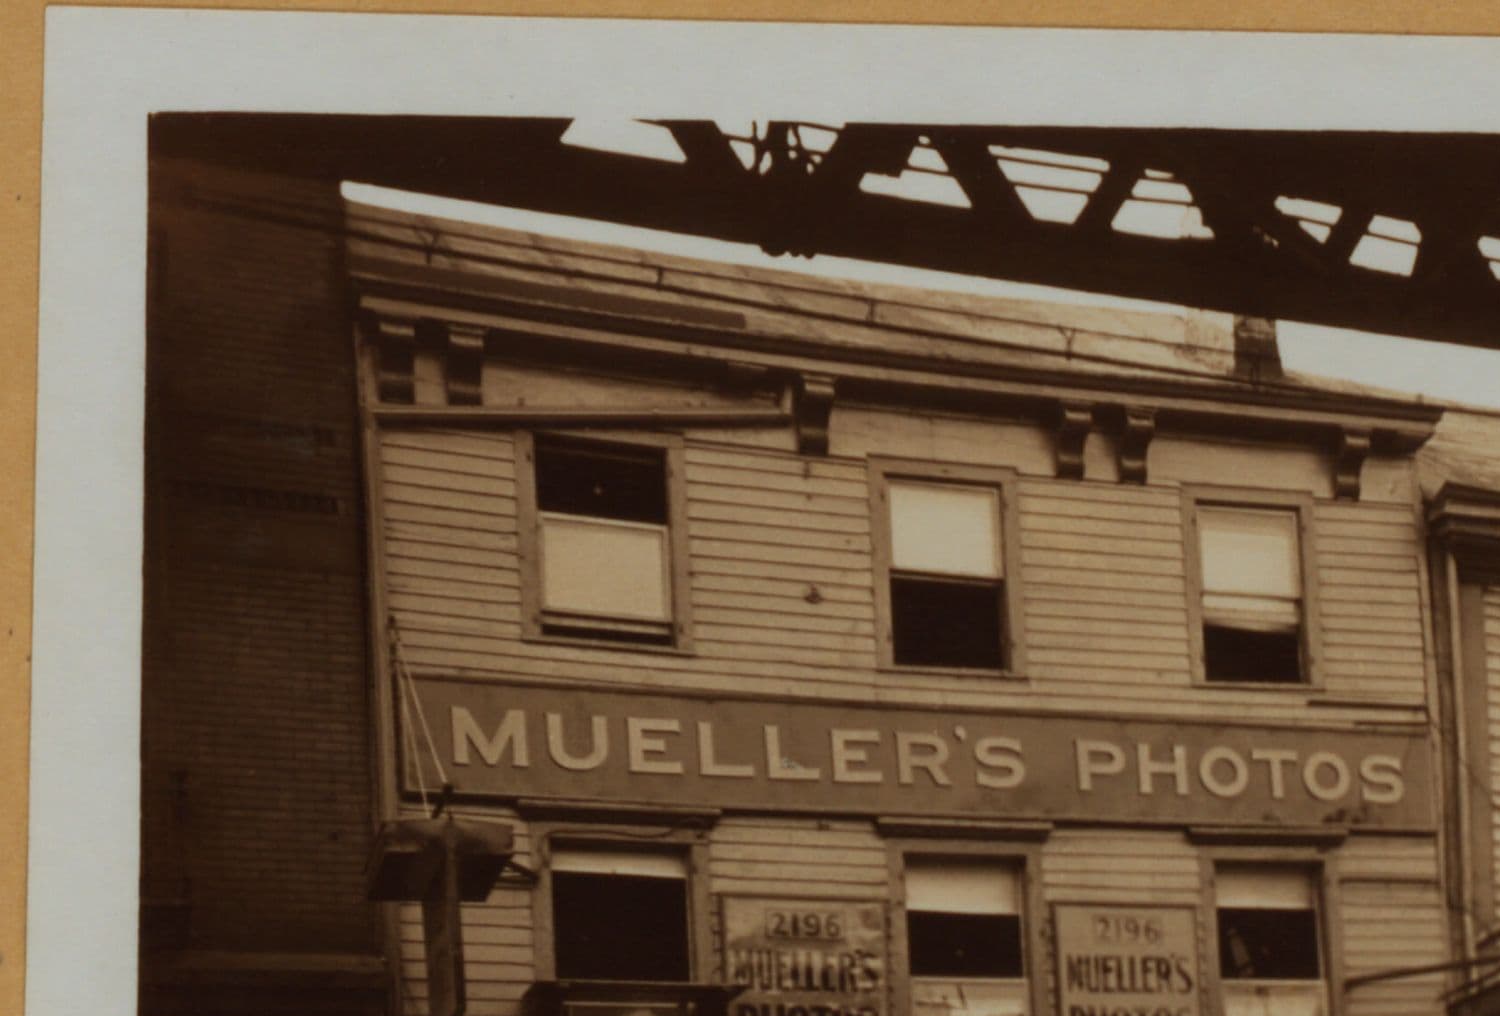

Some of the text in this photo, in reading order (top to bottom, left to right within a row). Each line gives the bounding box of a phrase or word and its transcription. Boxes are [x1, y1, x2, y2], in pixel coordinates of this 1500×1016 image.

[450, 706, 1404, 803] MUELLER'S PHOTOS
[772, 913, 840, 937] 2196
[1097, 916, 1162, 943] 2196
[734, 949, 879, 993] MUELLER'S
[1066, 953, 1194, 994] MUELLER'S
